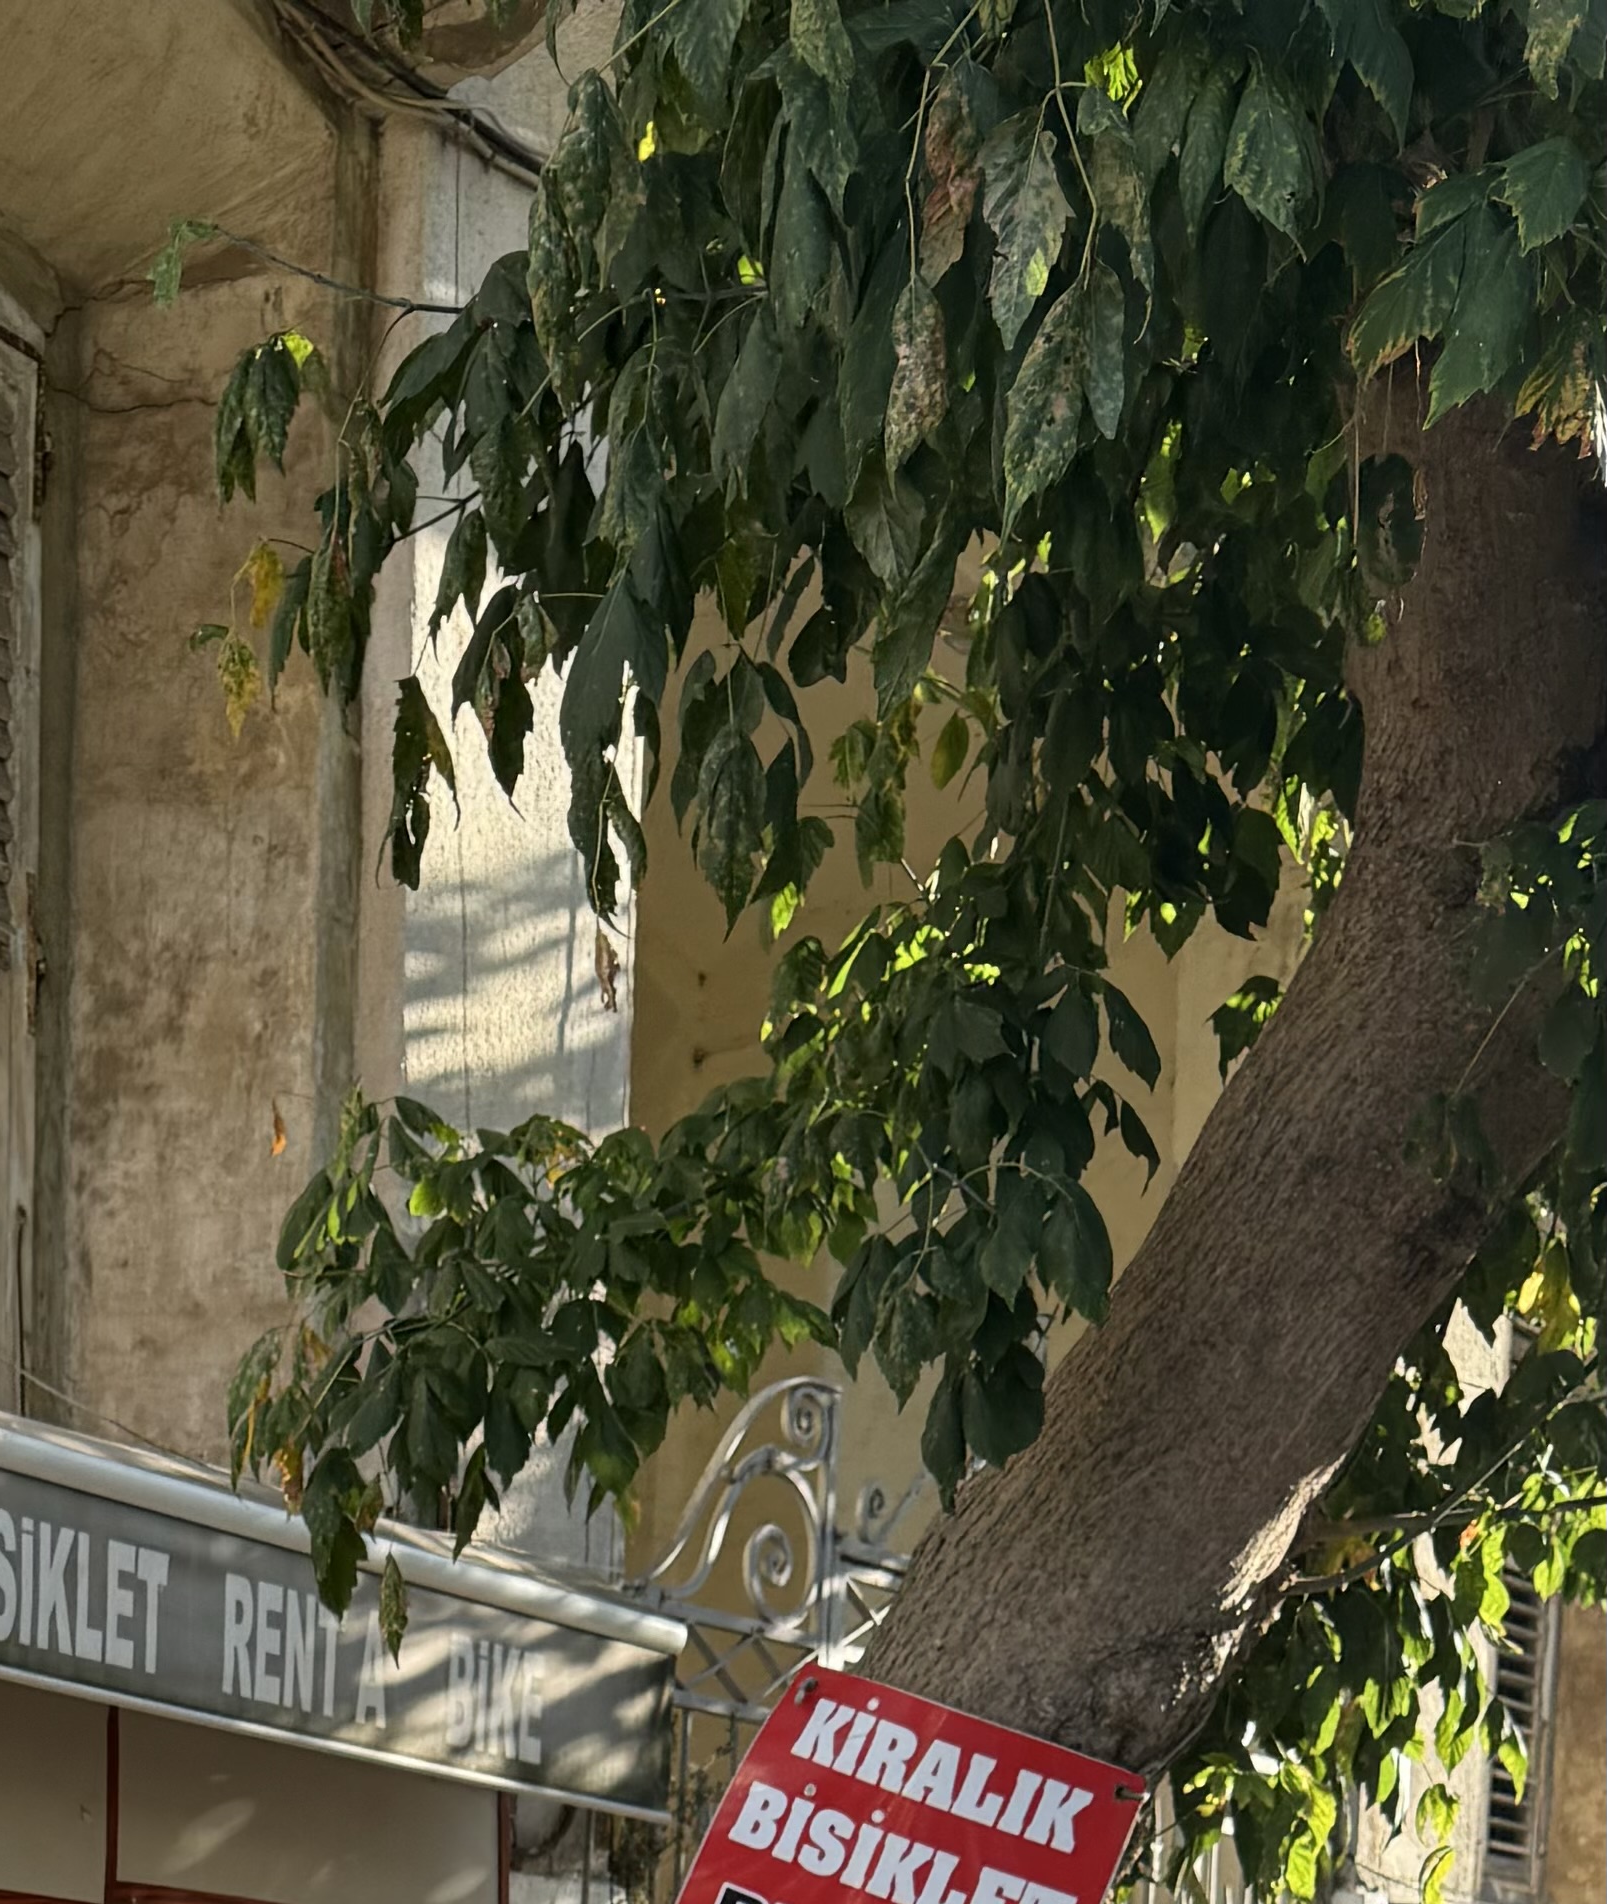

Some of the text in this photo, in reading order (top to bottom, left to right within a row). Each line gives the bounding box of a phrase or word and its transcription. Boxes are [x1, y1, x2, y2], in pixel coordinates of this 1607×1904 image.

[222, 1573, 342, 1719] RENT
[355, 1608, 388, 1729] A
[790, 1696, 1095, 1855] KİRALIK
